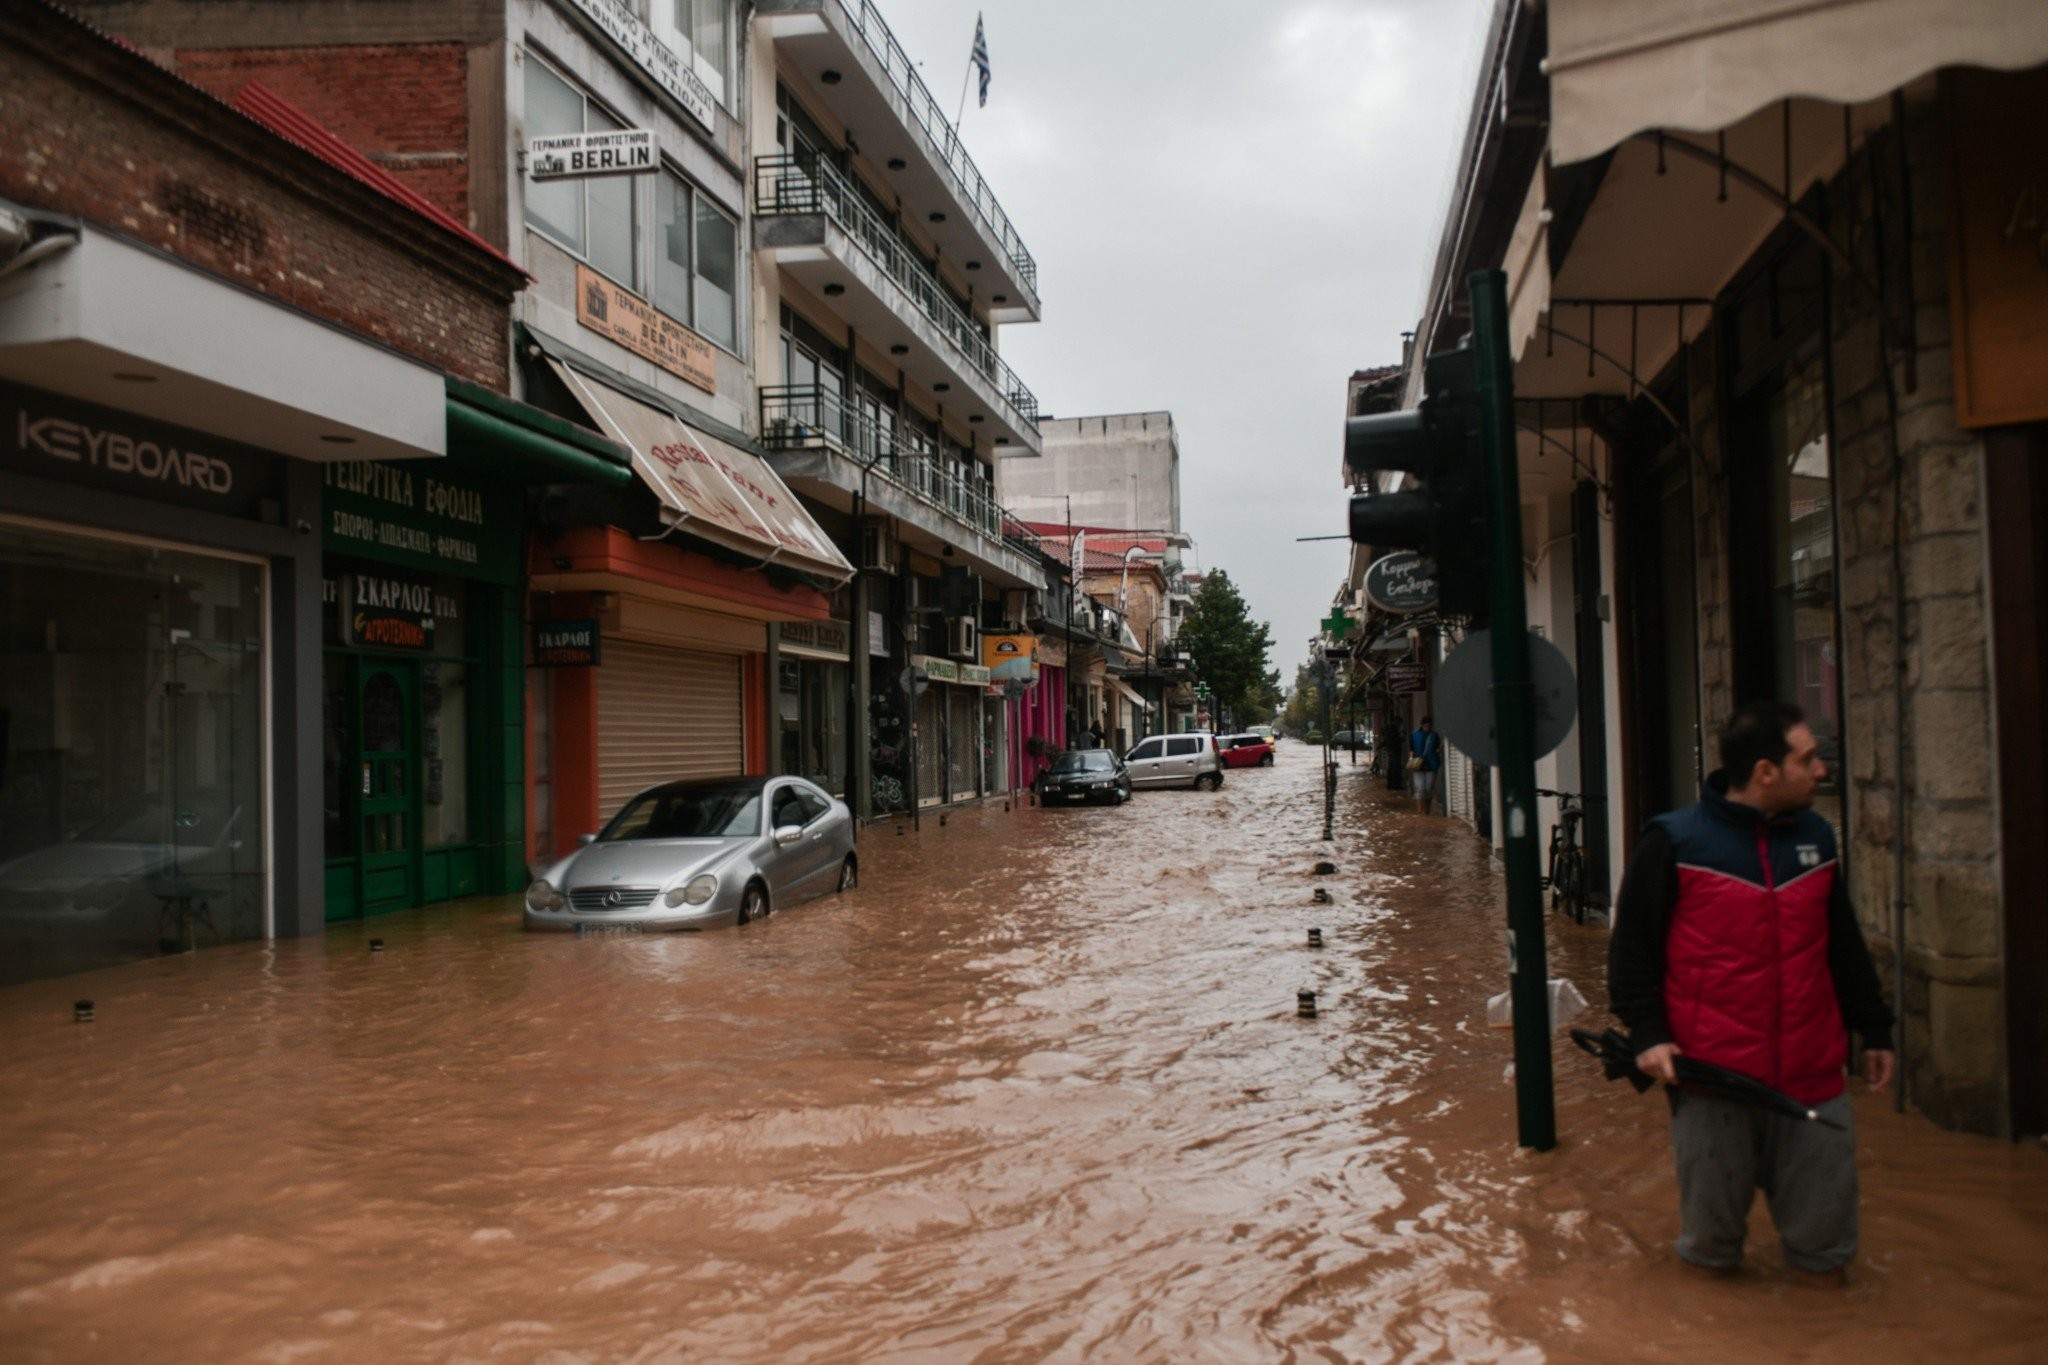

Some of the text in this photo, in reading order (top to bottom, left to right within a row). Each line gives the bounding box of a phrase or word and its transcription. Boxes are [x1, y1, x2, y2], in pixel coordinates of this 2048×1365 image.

[533, 132, 649, 151] ΓΕΡΜΑΝΙΚΟ ΦΡΟΝΤΙΣΤΗΡΙΟ
[571, 147, 650, 170] BERLIN
[614, 290, 659, 328] ΓΕΡΜΑΝΙΚΟ
[661, 320, 712, 360] ΦΡΟΝΤΙΣΤΗΡΙΟ
[641, 322, 689, 361] BERLIN
[18, 408, 234, 494] KEYBOARD
[325, 460, 484, 525] ΓΕΩΡΓΙΚΑ ΕΦΟΔΙΑ
[333, 510, 374, 538] ΣΠΟΡΟΙ
[378, 526, 432, 555] ΛΙΠΑΣΜΑΤΑ
[356, 575, 432, 615] ΣΚΑΡΛΟΣ
[538, 630, 591, 649] ΣΚΑΡΛΟΣ
